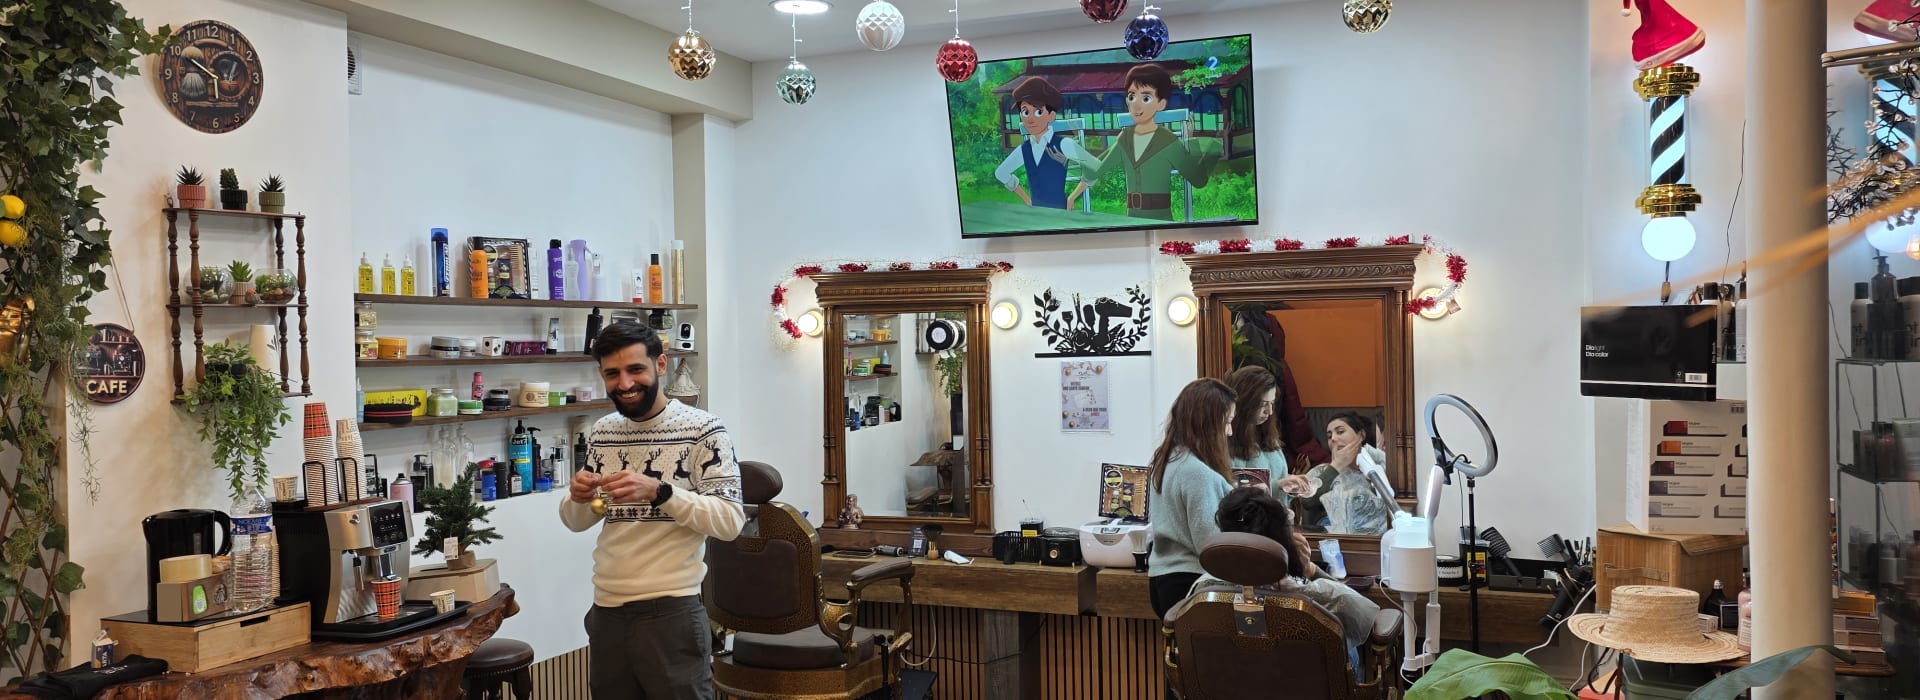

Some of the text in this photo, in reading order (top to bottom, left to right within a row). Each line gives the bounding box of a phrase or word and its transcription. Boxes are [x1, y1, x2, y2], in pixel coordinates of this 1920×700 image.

[186, 29, 197, 41] 11
[206, 25, 219, 37] 12
[230, 33, 235, 45] 1
[170, 45, 181, 56] 10
[246, 50, 253, 61] 2
[1208, 56, 1218, 71] 2
[164, 68, 172, 80] 9
[252, 72, 260, 84] 3
[172, 92, 178, 104] 8
[248, 95, 255, 106] 4
[190, 111, 196, 121] 7
[234, 113, 240, 123] 5
[212, 117, 219, 128] 6
[86, 380, 128, 394] CAFE
